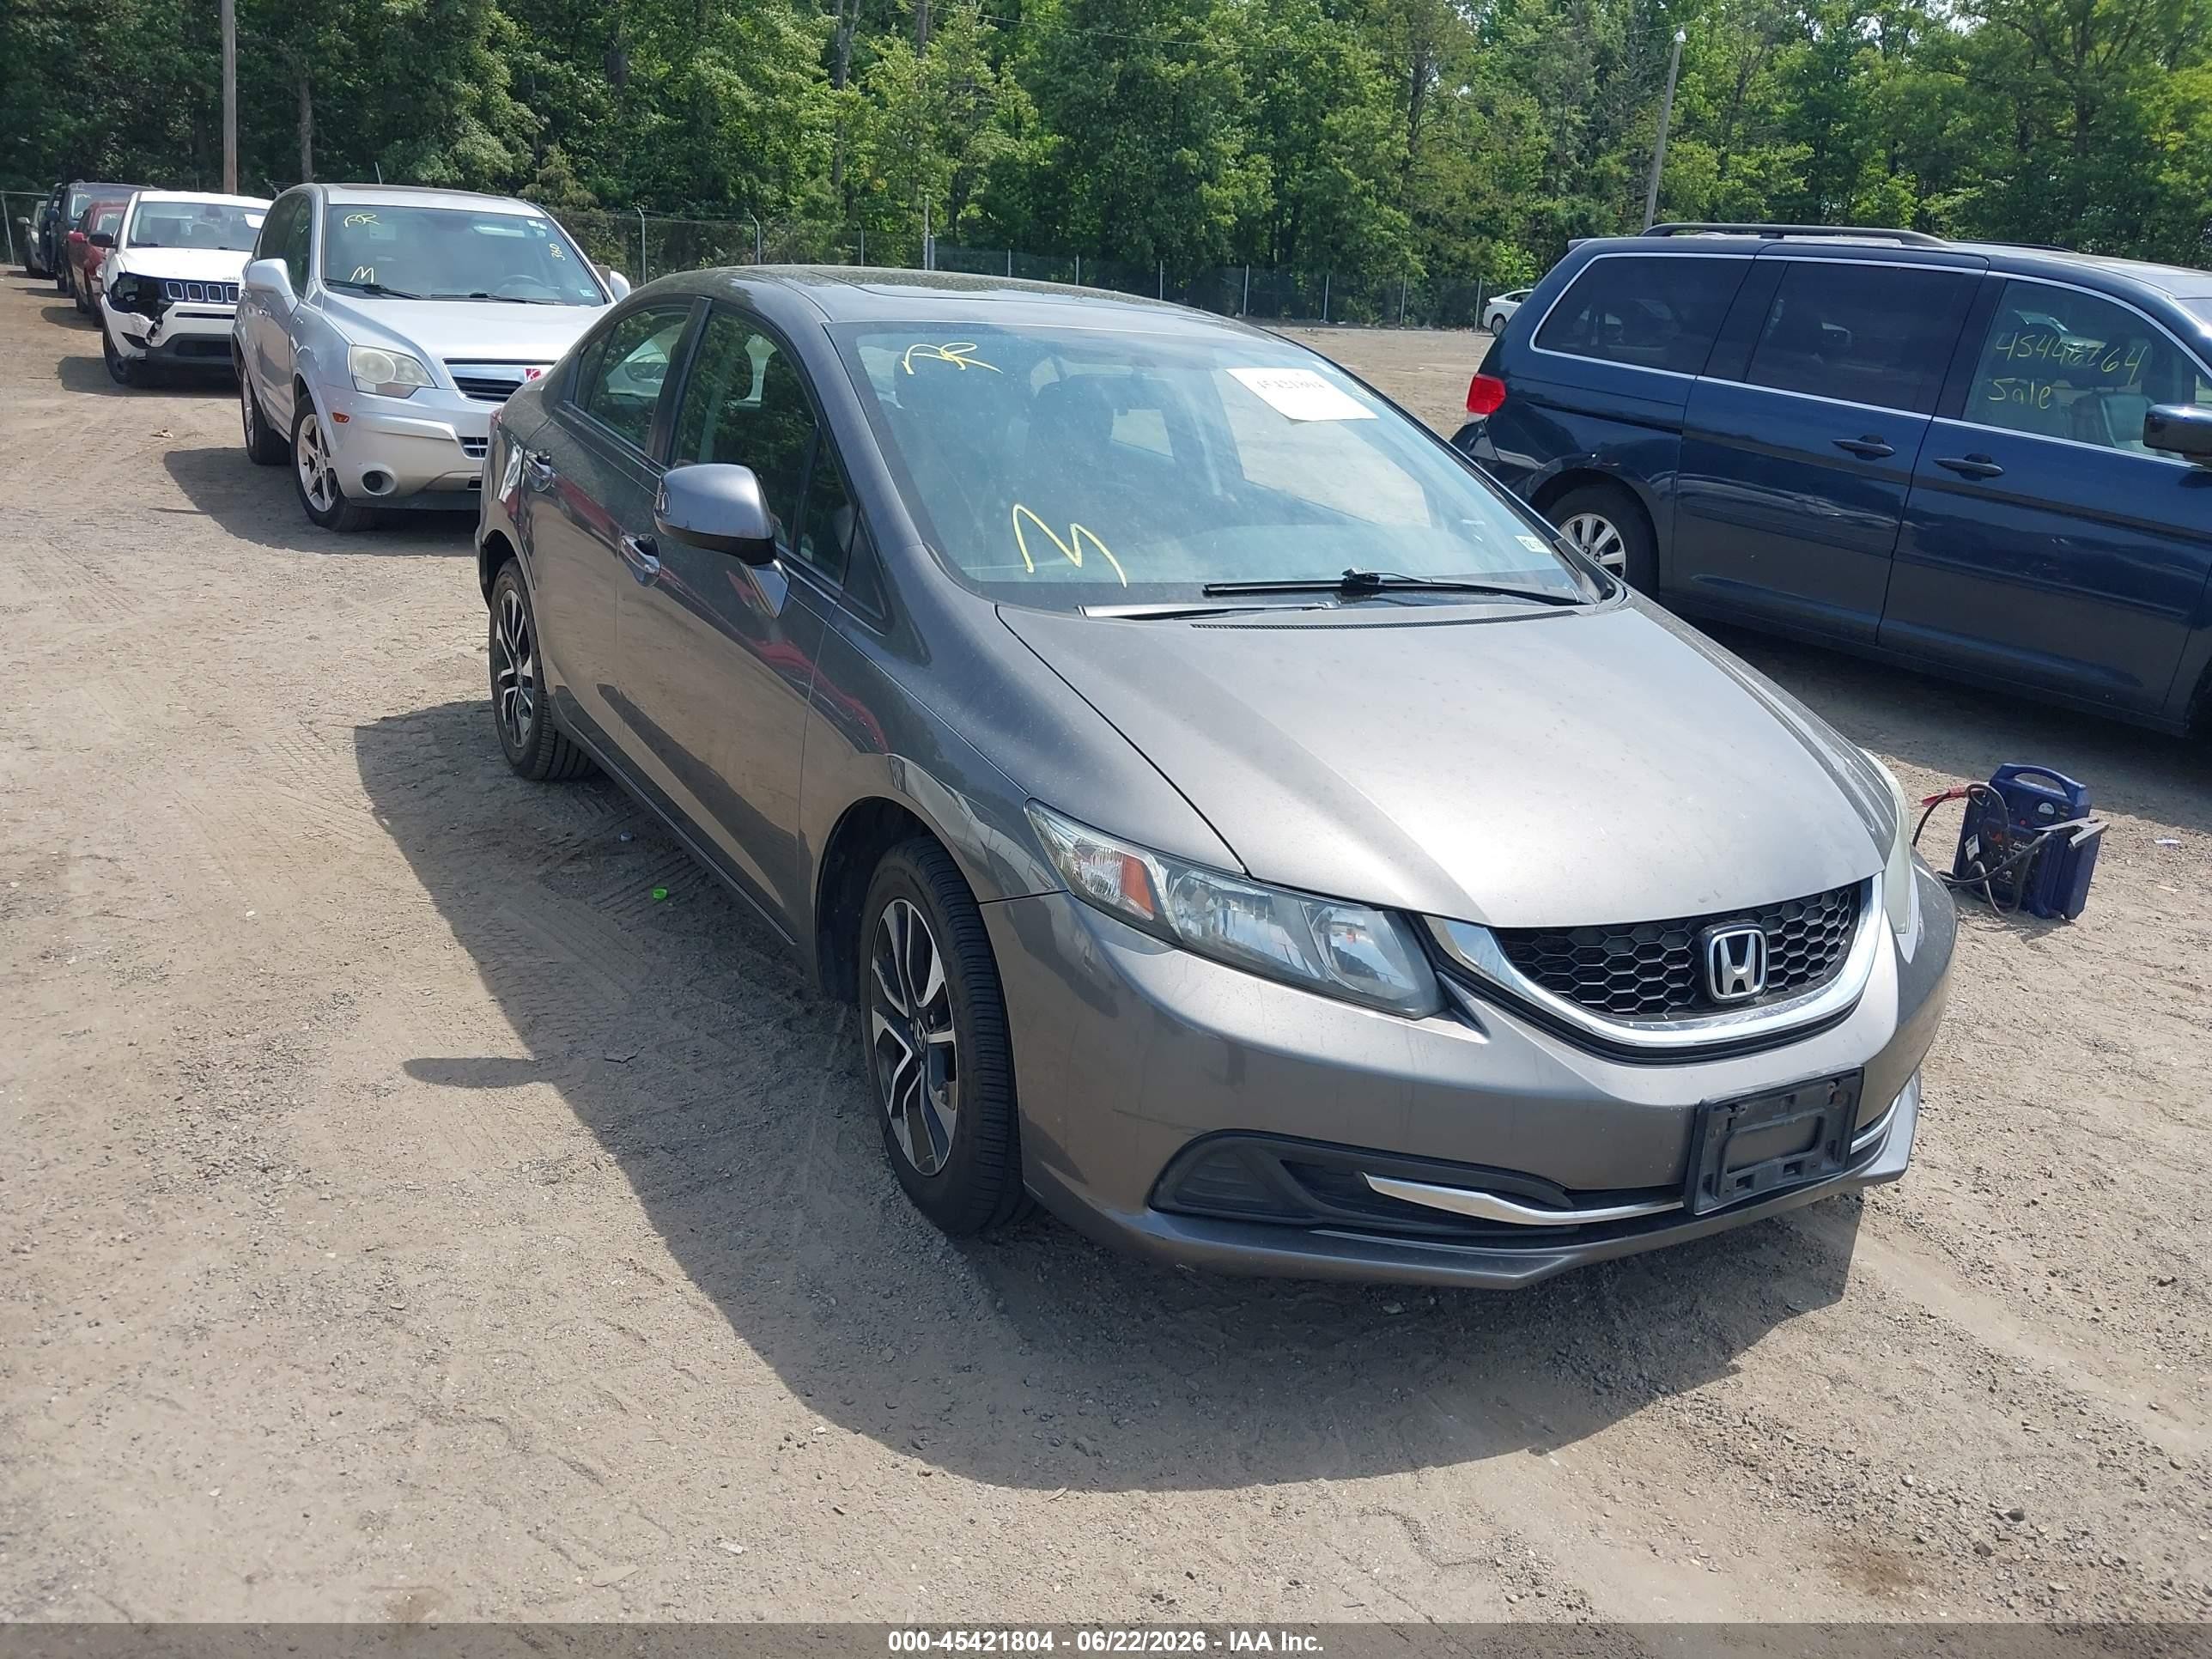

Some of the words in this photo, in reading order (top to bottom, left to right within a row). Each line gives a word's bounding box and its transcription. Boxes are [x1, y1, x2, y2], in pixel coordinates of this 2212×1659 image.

[349, 266, 374, 283] M
[1988, 378, 2052, 410] Sale
[1011, 503, 1127, 588] M
